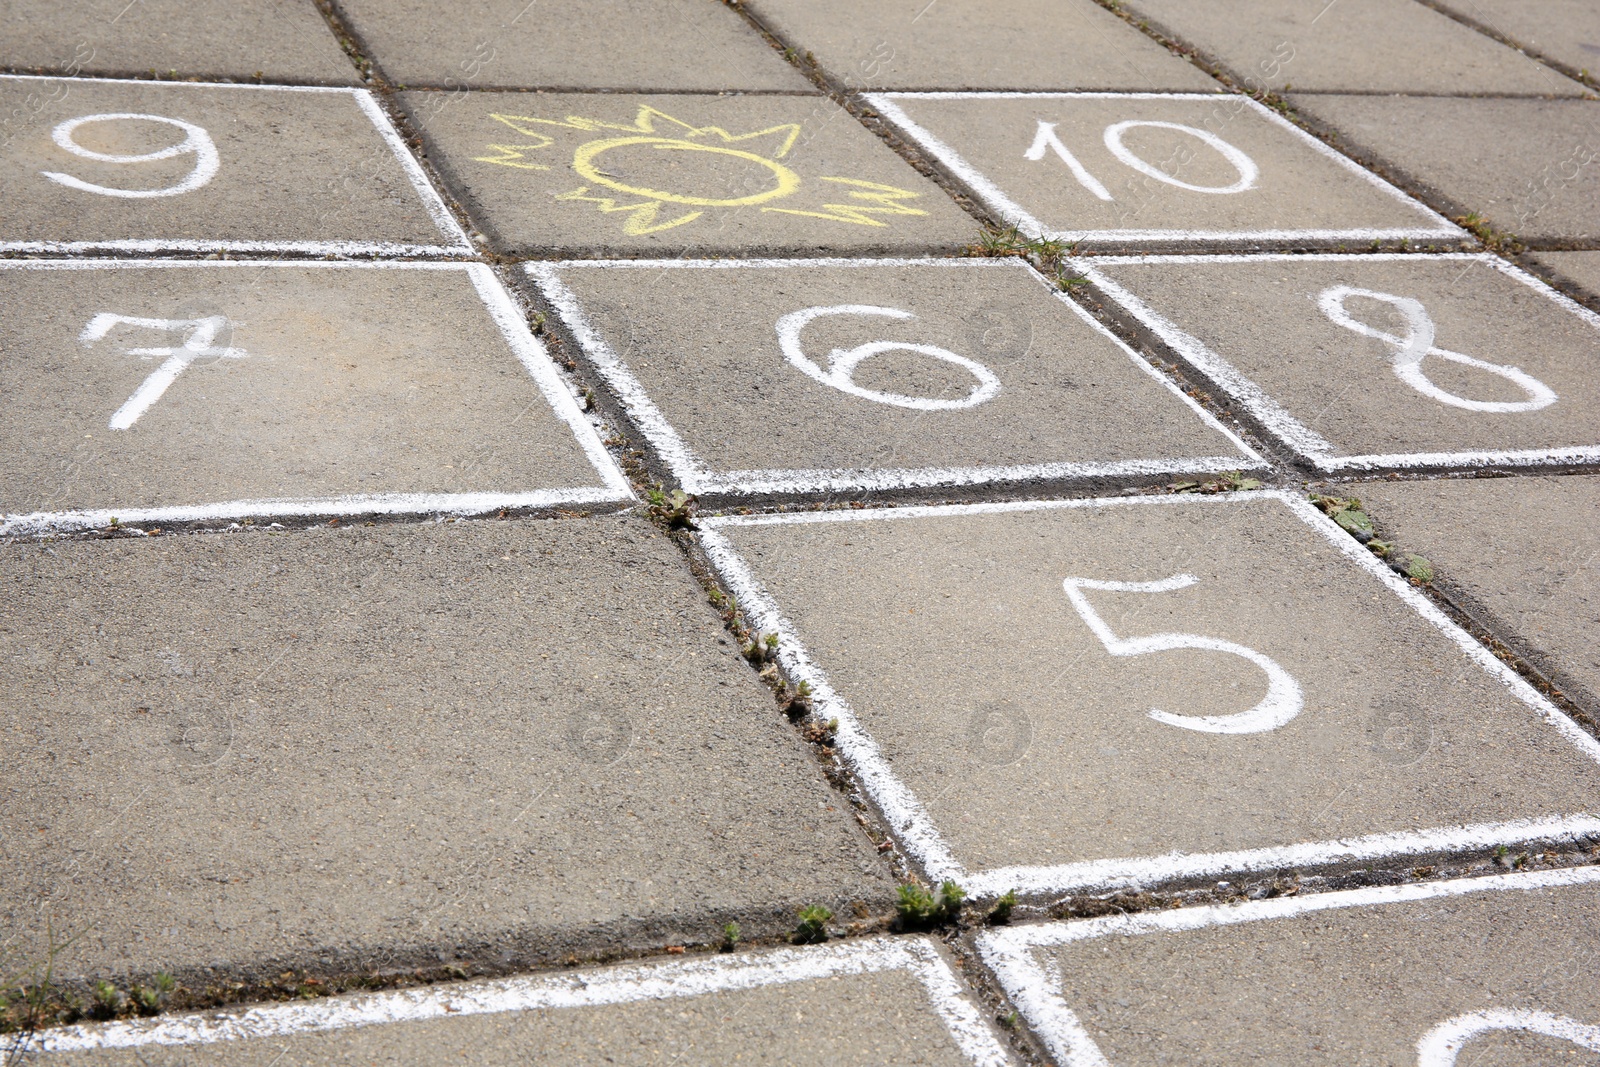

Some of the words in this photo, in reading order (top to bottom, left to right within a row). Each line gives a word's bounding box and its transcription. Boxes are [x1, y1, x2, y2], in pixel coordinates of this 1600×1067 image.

[42, 112, 221, 199] 9
[1024, 120, 1258, 201] 10
[78, 313, 251, 430] 7
[775, 304, 1001, 412] 6
[1318, 283, 1557, 413] 8
[1062, 571, 1306, 736] 5
